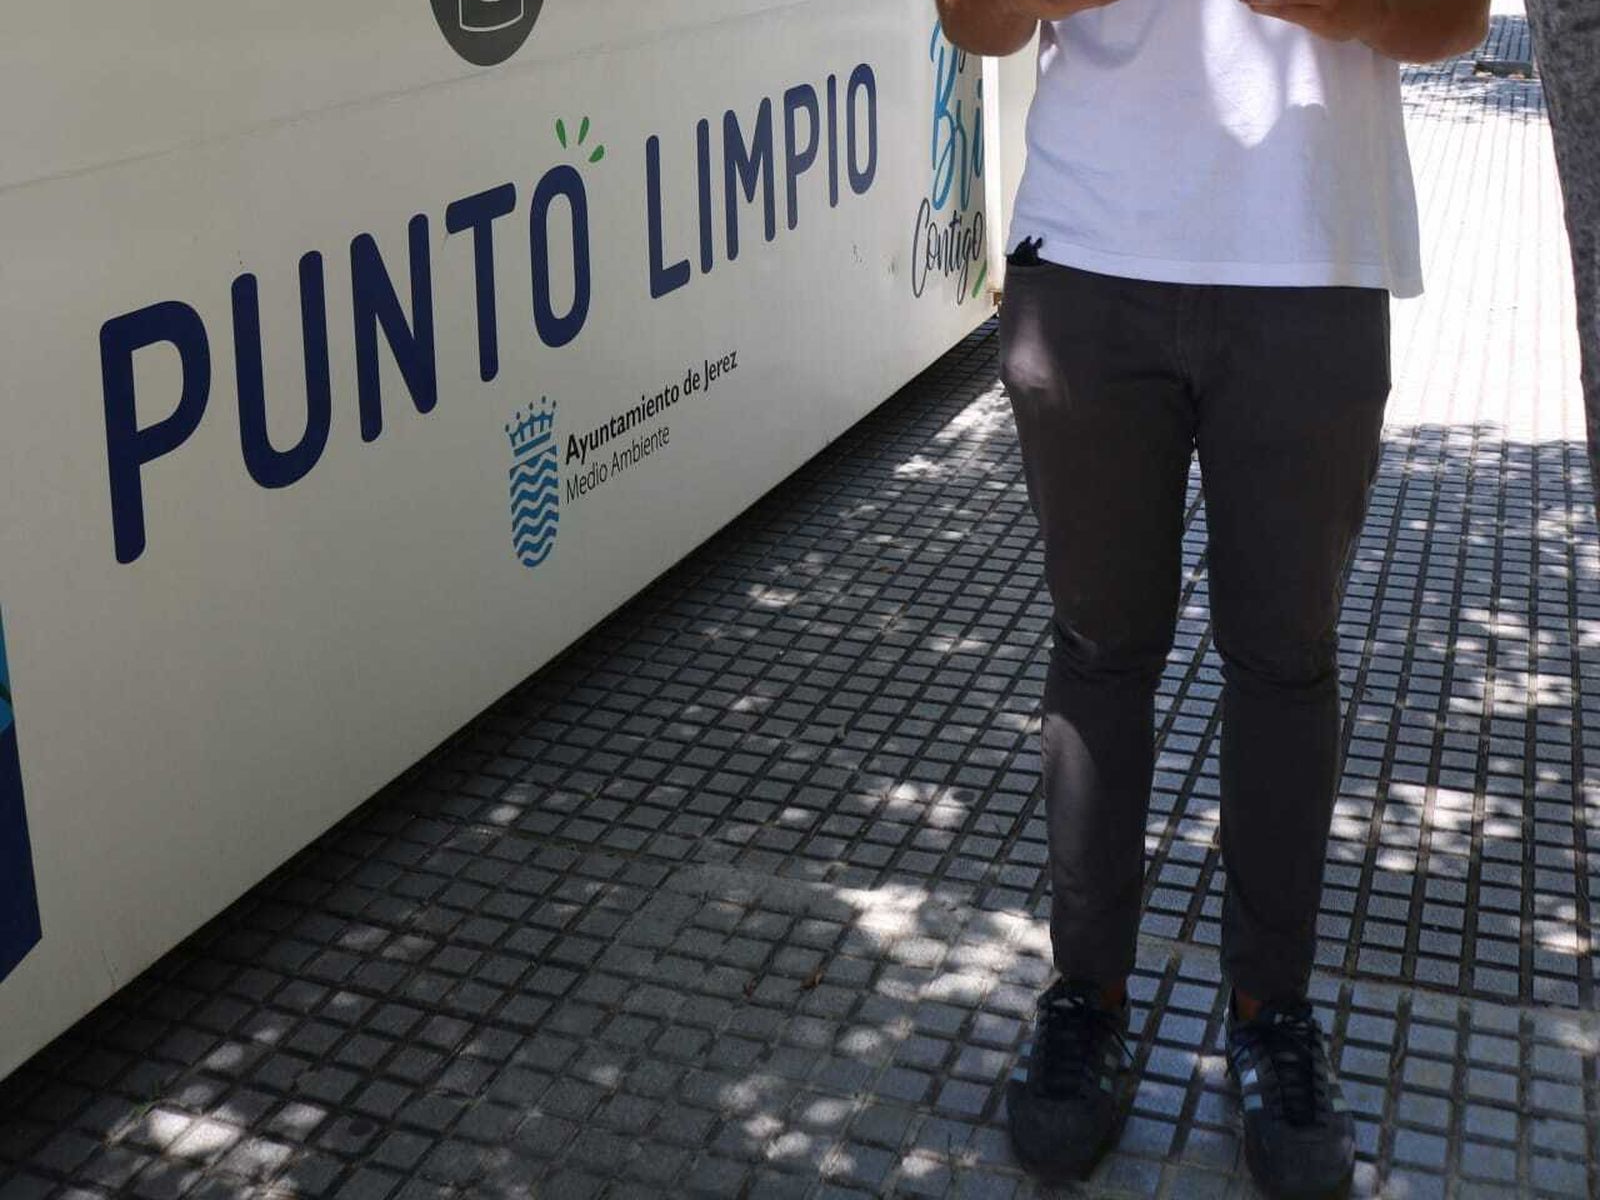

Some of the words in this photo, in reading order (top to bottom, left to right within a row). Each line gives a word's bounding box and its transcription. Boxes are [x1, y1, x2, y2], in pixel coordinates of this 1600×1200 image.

[912, 197, 983, 306] Contigo
[99, 165, 591, 565] PUNTO
[646, 63, 878, 299] LIMPIO
[565, 383, 680, 465] Ayuntamiento
[682, 368, 700, 396] de
[703, 350, 738, 392] Jerez
[566, 461, 608, 504] Medio
[611, 425, 670, 477] Ambiente
